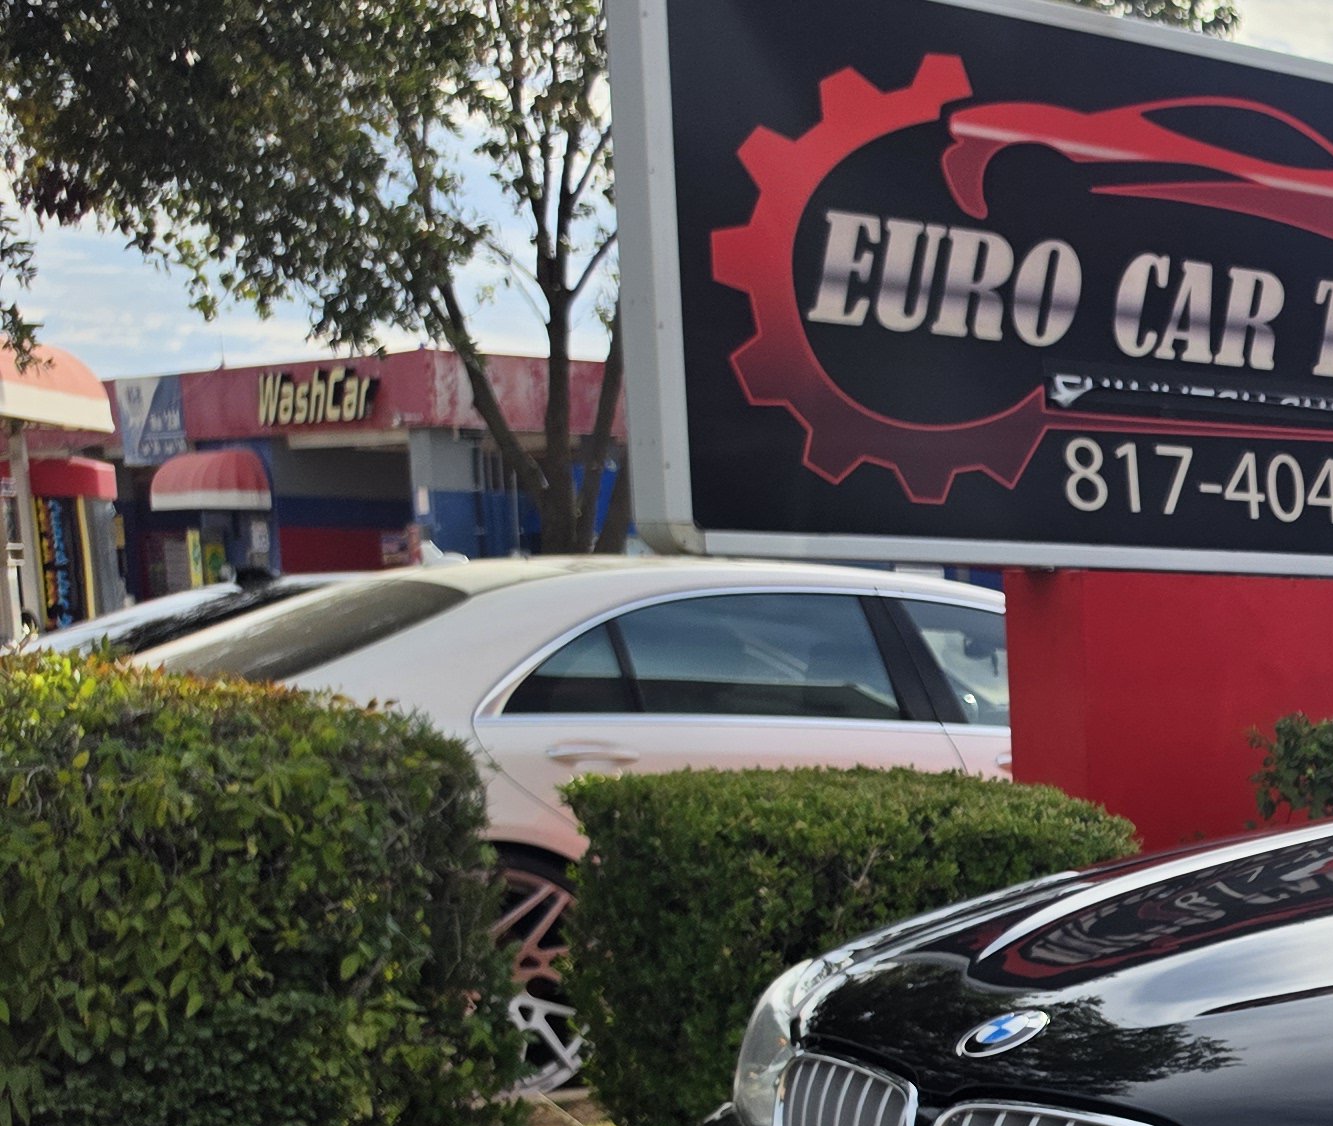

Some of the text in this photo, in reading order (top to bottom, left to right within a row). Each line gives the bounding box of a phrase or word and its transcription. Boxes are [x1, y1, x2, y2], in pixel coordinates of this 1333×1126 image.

[808, 209, 1083, 347] EURO
[1112, 251, 1286, 371] CAR
[258, 366, 371, 427] WashCar
